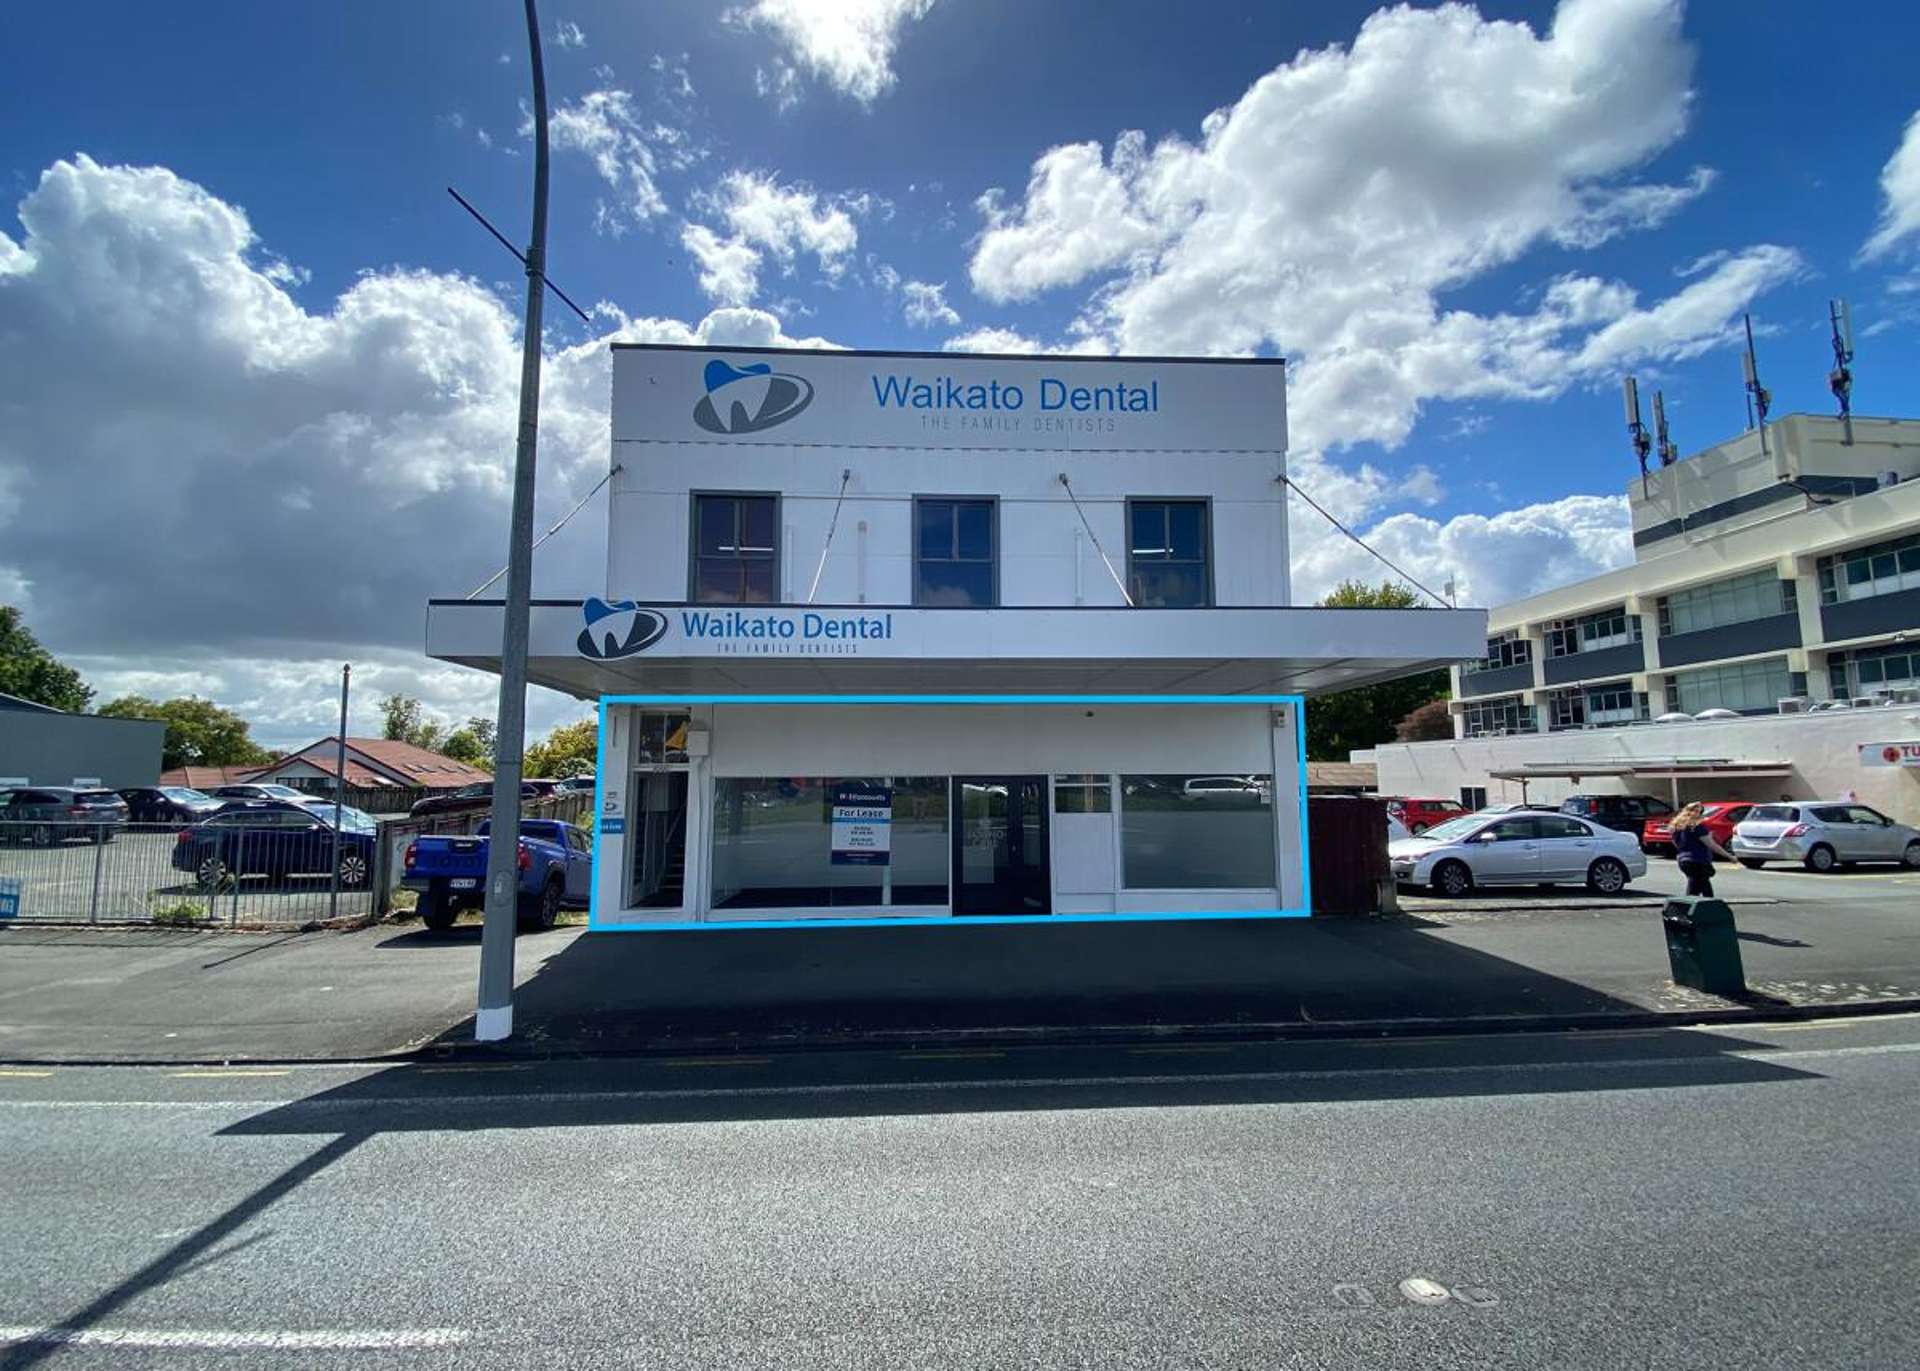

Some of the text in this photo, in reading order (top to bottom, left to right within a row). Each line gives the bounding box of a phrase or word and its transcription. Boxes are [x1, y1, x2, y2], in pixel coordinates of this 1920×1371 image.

[872, 375, 1158, 412] Waikato Dental
[921, 415, 1116, 432] THE FAMILY DENTISTS
[682, 612, 891, 639] Waikato Dental
[717, 643, 857, 654] THE FAMILY DENTISTS
[840, 808, 884, 818] For Lease
